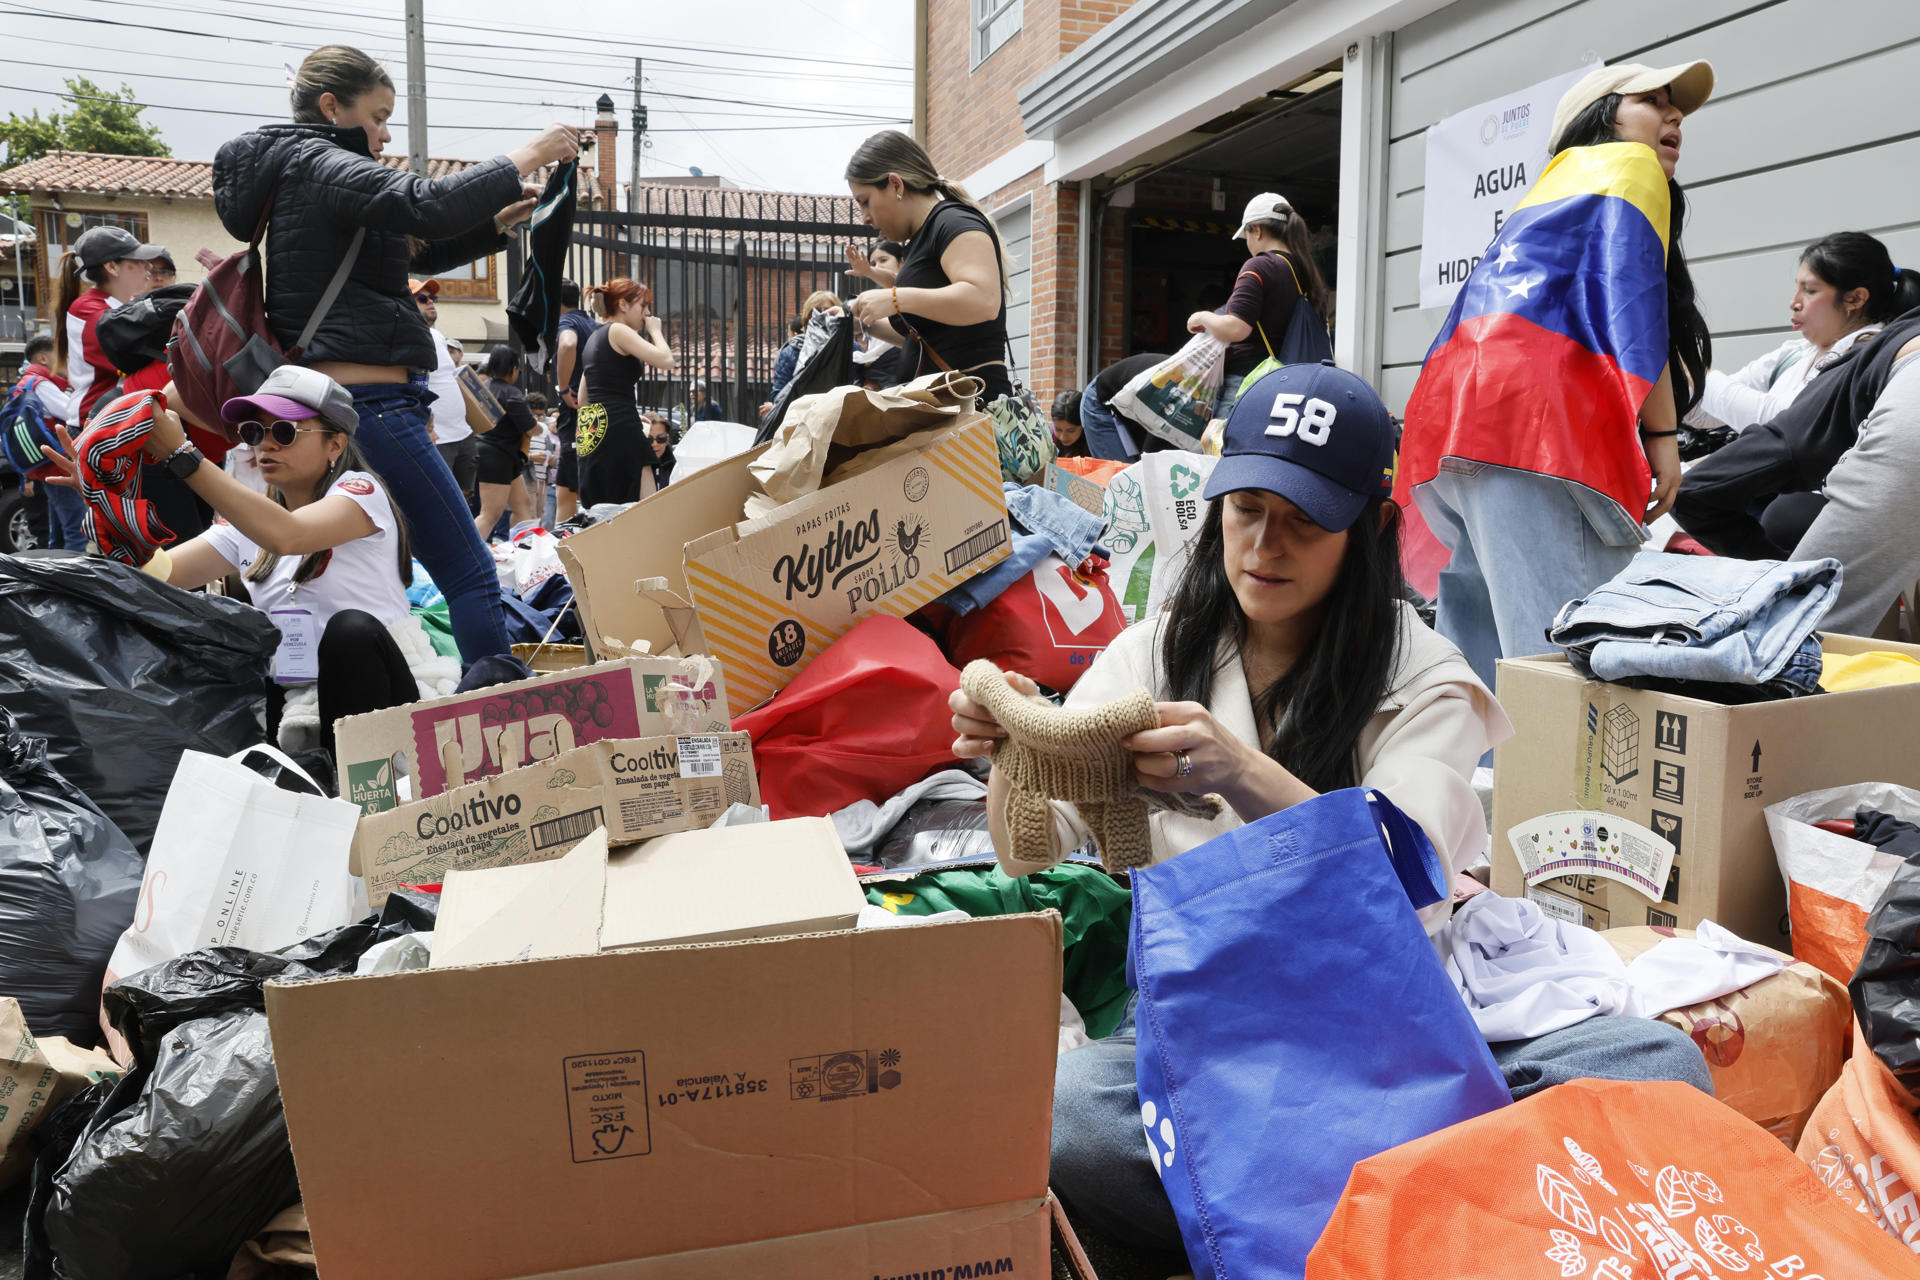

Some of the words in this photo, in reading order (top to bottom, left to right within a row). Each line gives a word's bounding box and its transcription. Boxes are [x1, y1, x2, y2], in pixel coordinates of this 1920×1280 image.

[1502, 103, 1530, 125] JUNTOS
[1474, 162, 1526, 199] AGUA
[1263, 392, 1337, 447] 58
[796, 516, 822, 537] PAPAS
[825, 502, 850, 523] FRITAS
[1175, 500, 1188, 530] BOLSA
[1186, 500, 1197, 520] ECO
[773, 508, 881, 600] Kythos
[846, 555, 920, 614] POLLO
[854, 568, 874, 584] SABOR
[773, 623, 797, 651] 18
[1069, 651, 1085, 665] de
[1586, 734, 1594, 763] GRUPO
[610, 745, 680, 773] Cooltiv
[352, 783, 365, 793] LA
[615, 774, 649, 785] Ensalada
[660, 771, 680, 782] vegeta
[653, 780, 670, 790] papa
[1746, 776, 1763, 784] STORE
[353, 788, 392, 803] HUERTA
[1744, 792, 1755, 800] SIDE
[416, 790, 522, 840] Cooltivo
[426, 838, 465, 856] Ensalada
[466, 834, 476, 845] de
[477, 823, 520, 841] vegetales
[471, 840, 492, 853] papa
[371, 876, 379, 885] 24
[216, 868, 244, 928] ONLINE
[37, 1066, 54, 1088] uta
[676, 1074, 729, 1087] Valencia
[7, 1080, 19, 1097] App
[592, 1091, 622, 1102] MIXTO
[658, 1079, 768, 1107] 358117A-01
[29, 1091, 45, 1107] de
[591, 1111, 625, 1125] FSC
